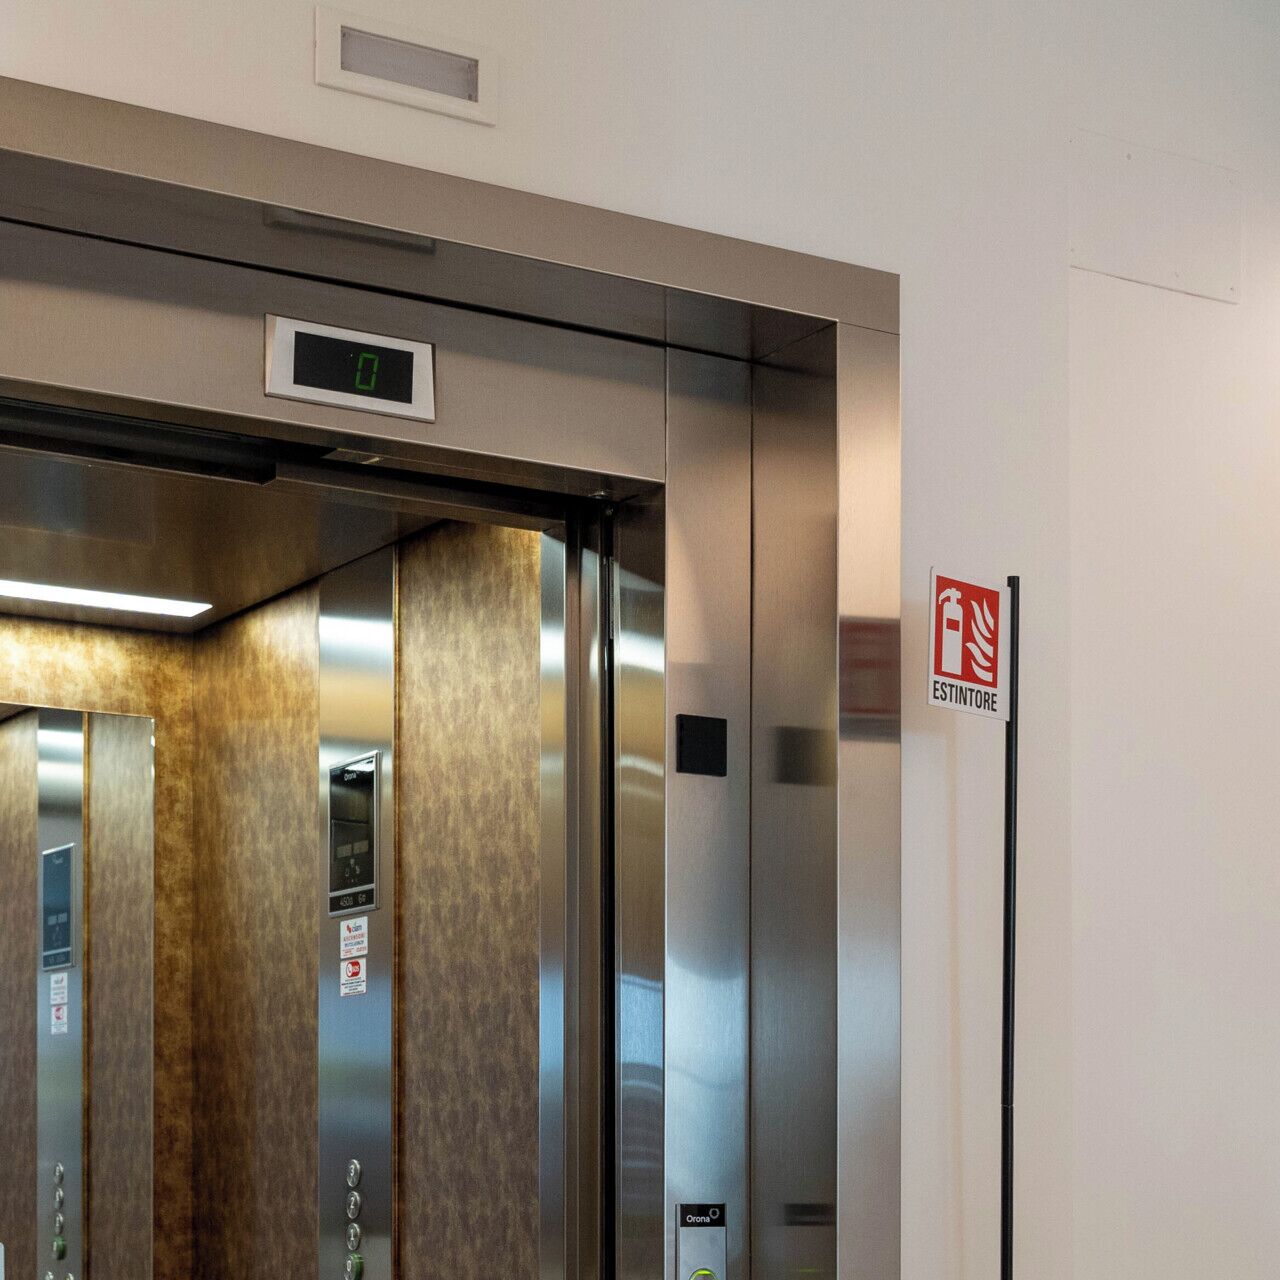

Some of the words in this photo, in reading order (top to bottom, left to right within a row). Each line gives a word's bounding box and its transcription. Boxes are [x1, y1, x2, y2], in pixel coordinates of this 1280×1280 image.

[355, 352, 379, 391] 0
[933, 680, 998, 712] ESTINTORE
[686, 1214, 711, 1223] Orona
